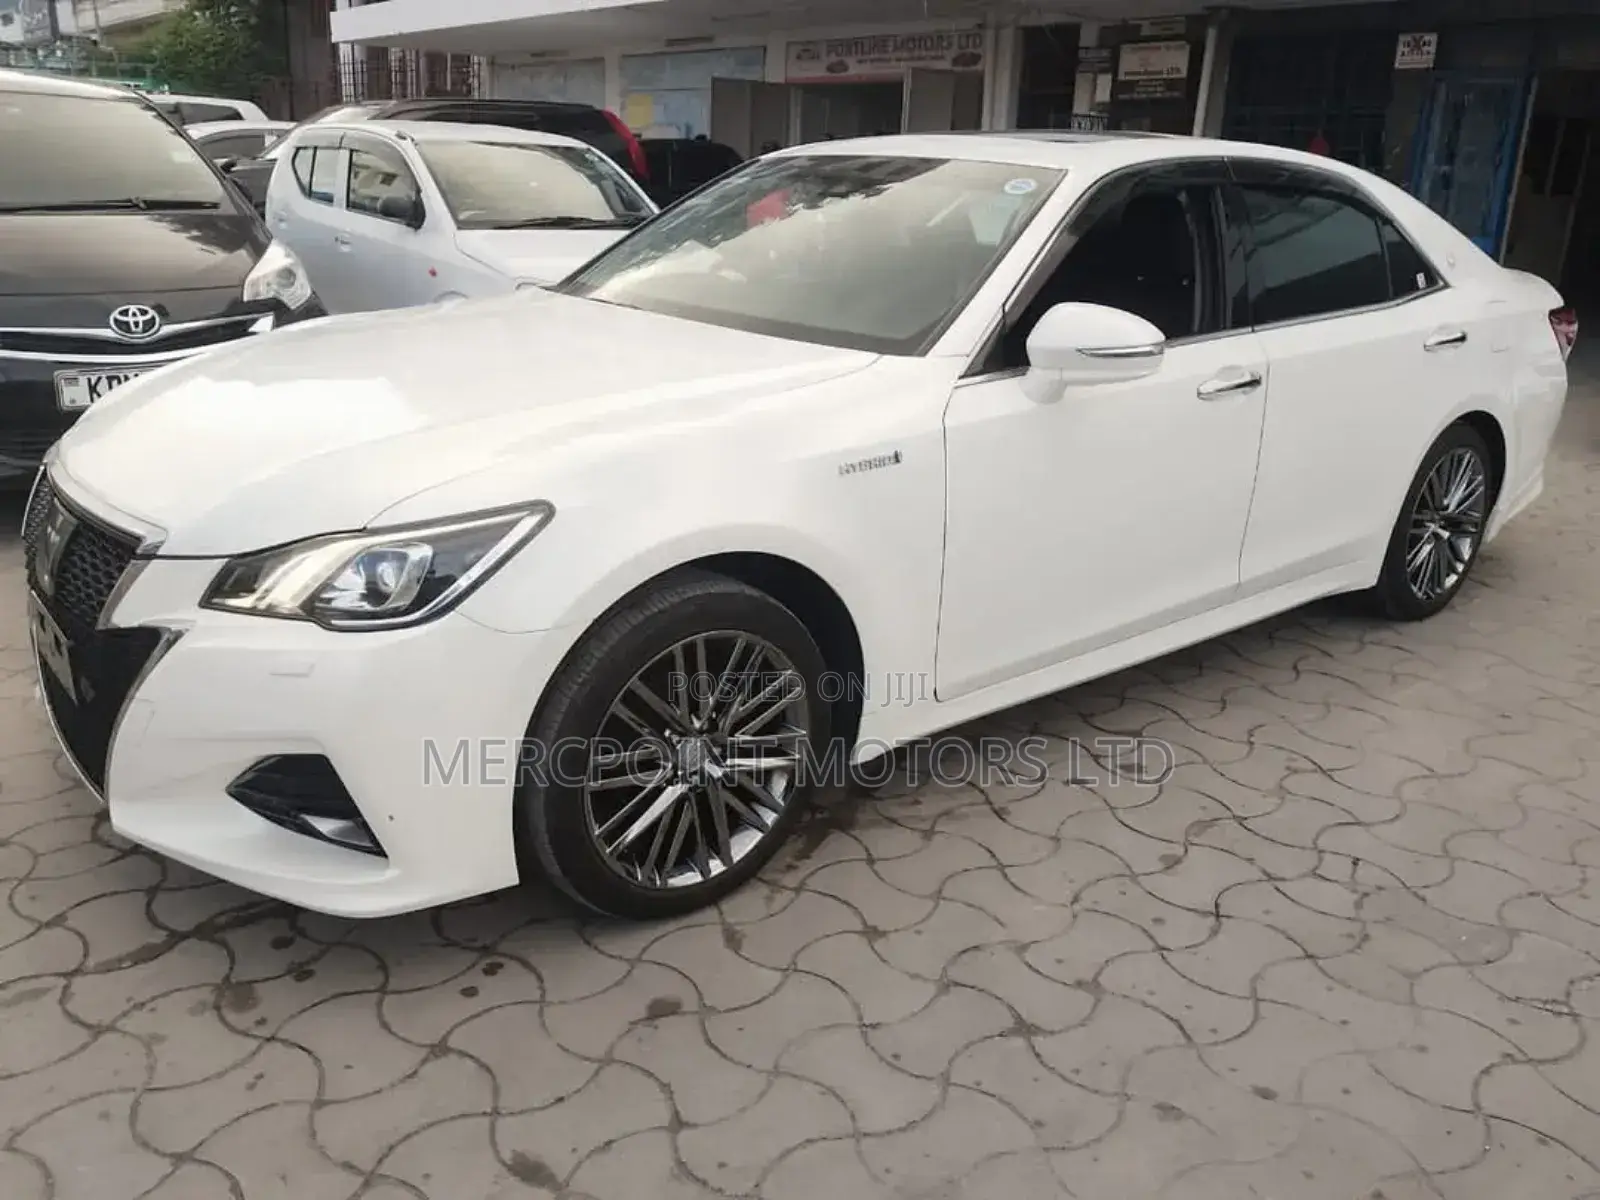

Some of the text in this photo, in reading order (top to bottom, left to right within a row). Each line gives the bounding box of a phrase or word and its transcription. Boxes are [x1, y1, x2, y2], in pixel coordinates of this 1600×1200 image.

[894, 34, 953, 52] MOTORS
[957, 32, 983, 50] LTD
[838, 452, 898, 475] HYBRID
